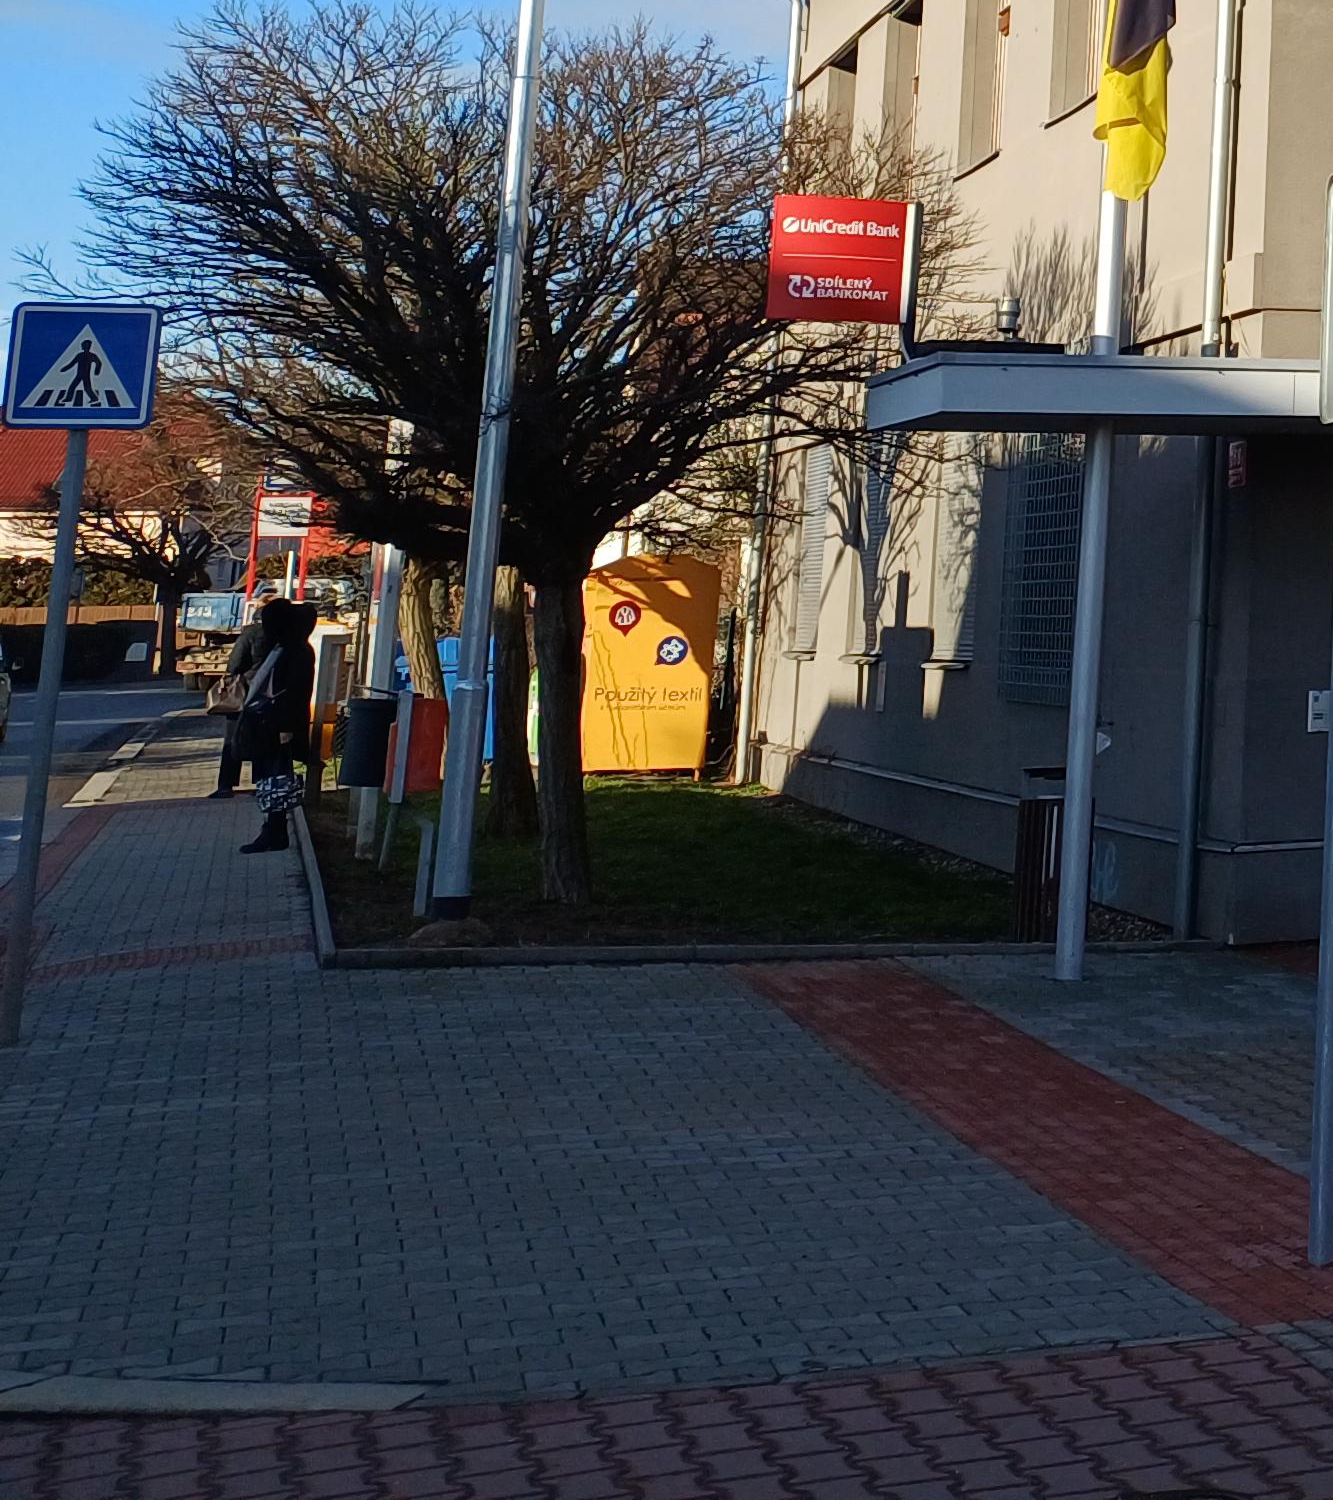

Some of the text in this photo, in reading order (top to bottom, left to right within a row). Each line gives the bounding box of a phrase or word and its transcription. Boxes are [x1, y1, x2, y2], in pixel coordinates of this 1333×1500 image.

[800, 217, 900, 238] UniCredit Bank
[817, 275, 873, 289] SDÍLENÝ
[816, 289, 889, 301] BANKOMAT
[594, 686, 703, 704] Použitý textil
